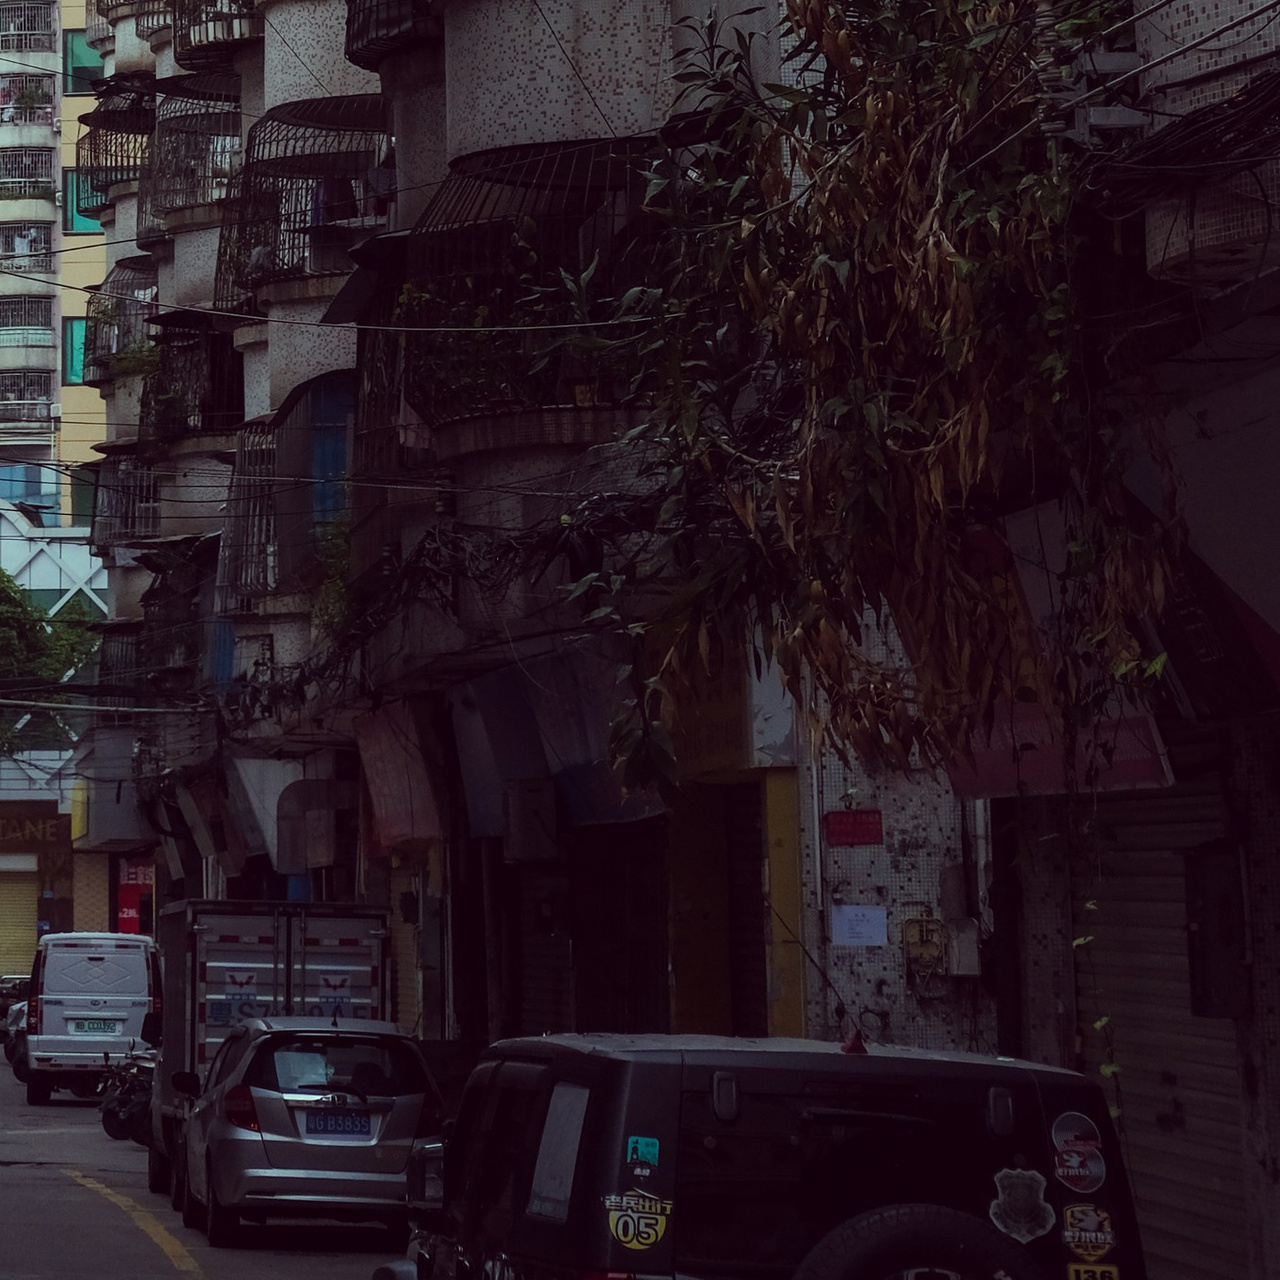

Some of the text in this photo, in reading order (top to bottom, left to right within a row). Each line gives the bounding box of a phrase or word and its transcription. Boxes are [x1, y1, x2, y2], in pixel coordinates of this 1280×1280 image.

[605, 1194, 674, 1216] 老兵出行
[616, 1213, 658, 1246] 05
